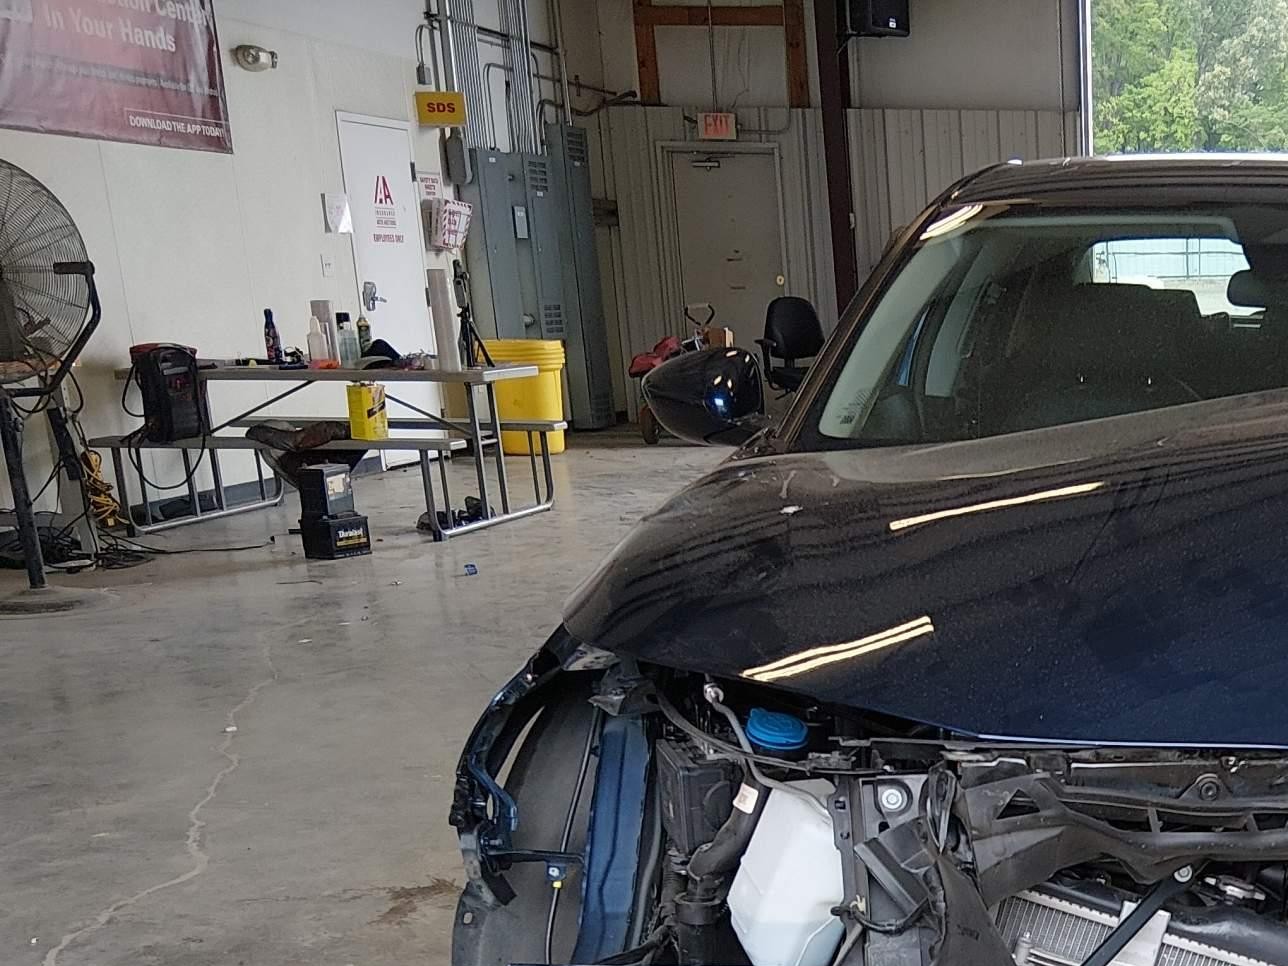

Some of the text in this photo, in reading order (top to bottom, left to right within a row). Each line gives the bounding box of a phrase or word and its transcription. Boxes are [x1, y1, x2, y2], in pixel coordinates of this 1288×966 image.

[45, 2, 176, 53] In Your Hands
[426, 102, 456, 113] SDS
[128, 114, 172, 131] DOWNLOAD
[172, 121, 186, 133] THE
[186, 123, 202, 135] APP
[704, 114, 731, 135] EXIT
